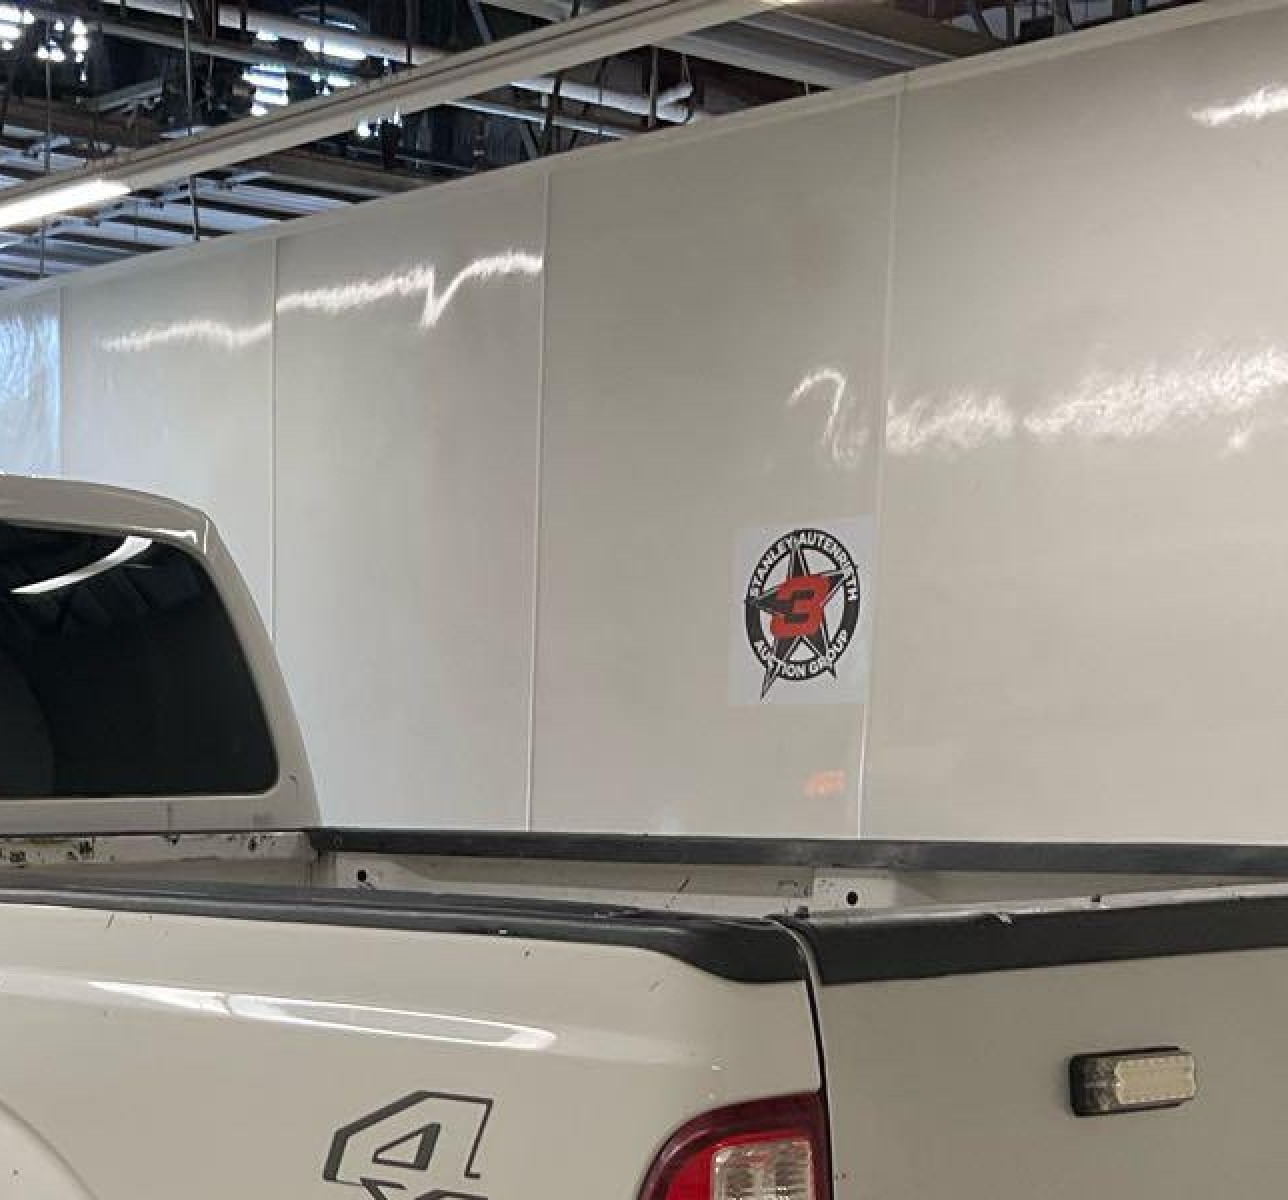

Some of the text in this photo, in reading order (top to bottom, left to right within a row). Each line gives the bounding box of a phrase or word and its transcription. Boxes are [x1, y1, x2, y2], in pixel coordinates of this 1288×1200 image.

[770, 575, 830, 639] 3
[754, 629, 848, 676] AUCTION GROUP
